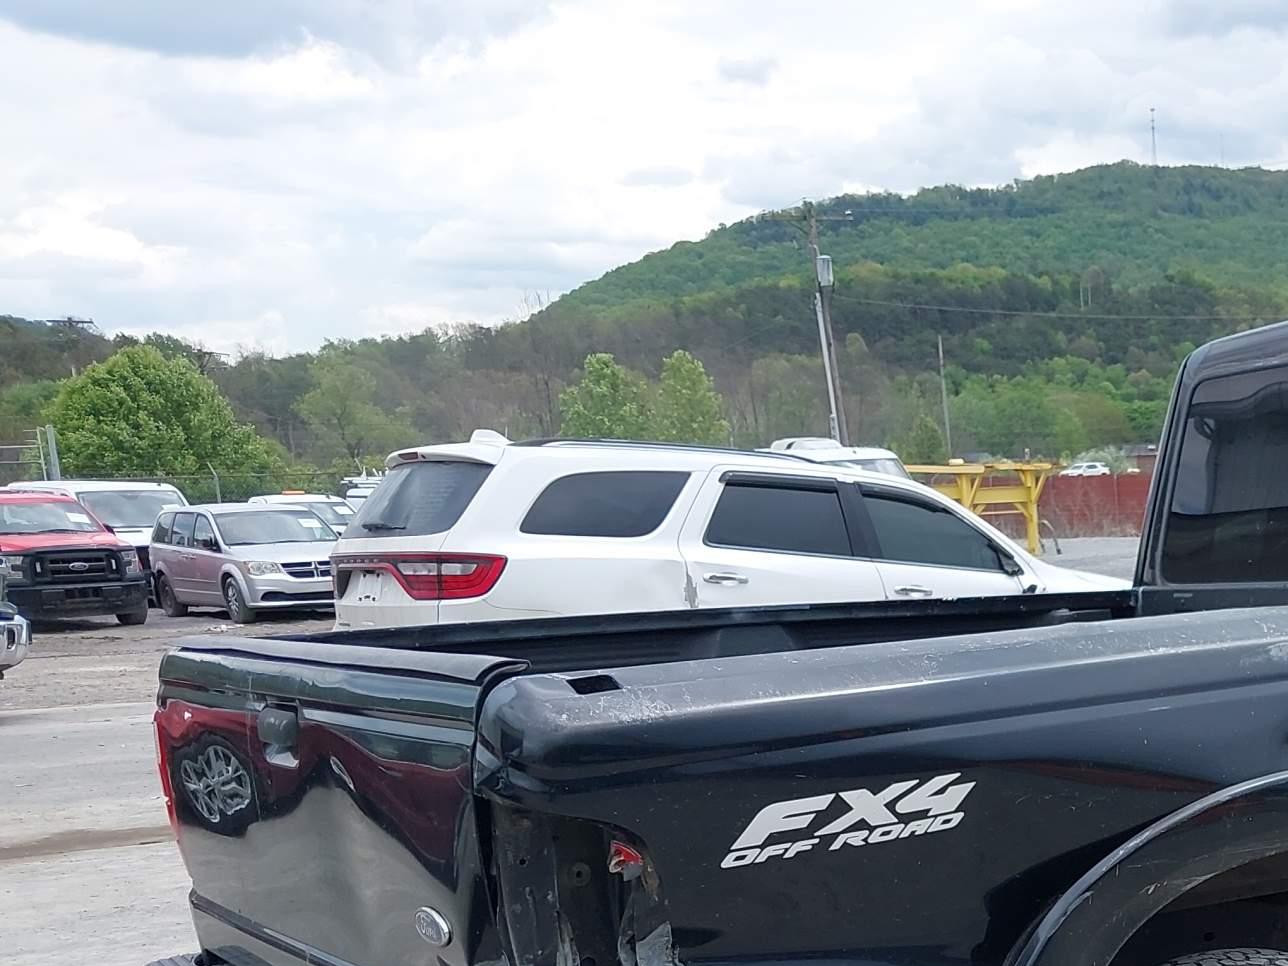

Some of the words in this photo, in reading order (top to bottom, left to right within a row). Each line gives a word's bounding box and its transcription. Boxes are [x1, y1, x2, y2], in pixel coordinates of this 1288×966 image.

[720, 838, 820, 869] OFF
[829, 811, 965, 850] ROAD
[730, 771, 977, 850] FX4
